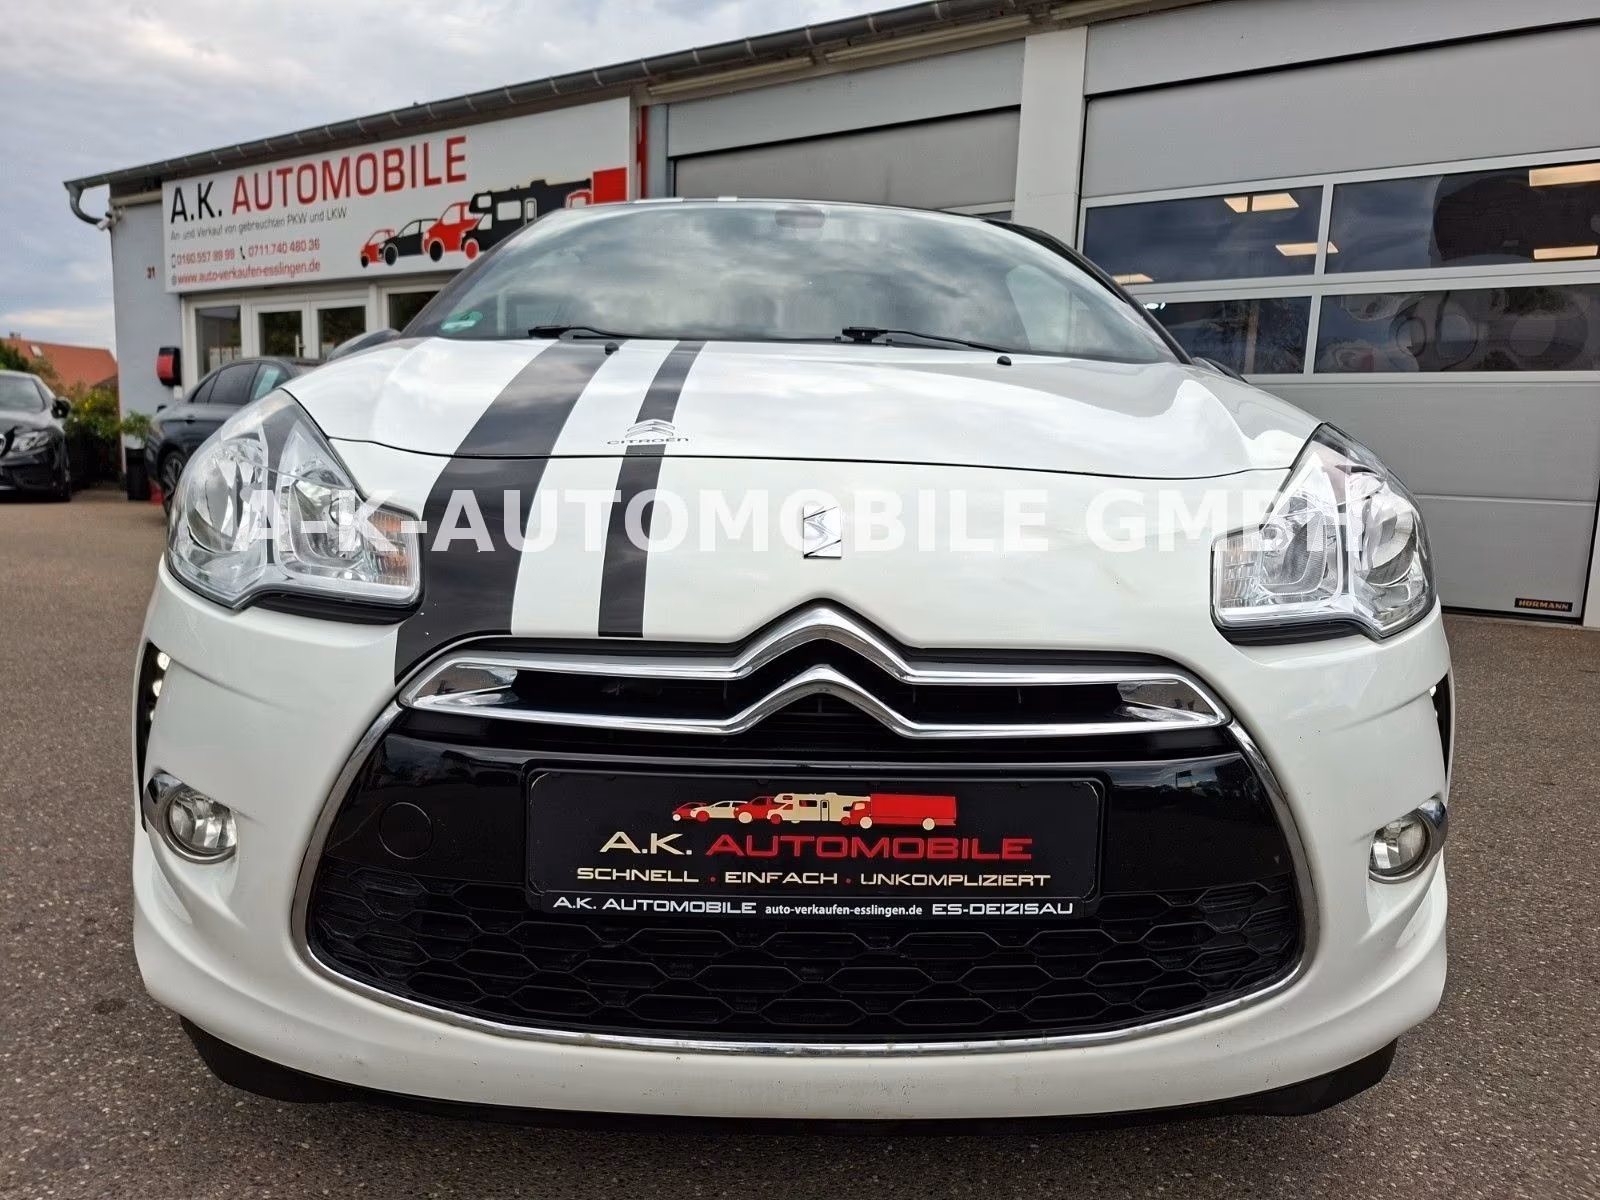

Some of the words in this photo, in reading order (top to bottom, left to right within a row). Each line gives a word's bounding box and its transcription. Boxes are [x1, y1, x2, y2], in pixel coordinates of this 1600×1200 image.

[170, 180, 222, 224] A.K.
[231, 136, 467, 215] AUTOMOBILE
[183, 228, 195, 240] und
[197, 225, 223, 238] Verkauf
[224, 225, 236, 236] von
[238, 219, 285, 235] gebrauchten
[287, 214, 307, 226] PKW
[310, 212, 325, 223] und
[327, 207, 348, 220] LKW
[600, 831, 693, 856] A.K.
[705, 834, 1033, 861] AUTOMOBILE
[577, 867, 700, 883] SCHNELL
[725, 871, 838, 885] EINFACH
[860, 873, 1051, 887] UNKOMPLIZIERT
[553, 896, 596, 910] A.K.
[602, 898, 757, 914] AUTOMOBILE
[765, 902, 923, 918] auto-verkaufen-esslingen.de
[932, 903, 1073, 916] ES-DEIZISAU
